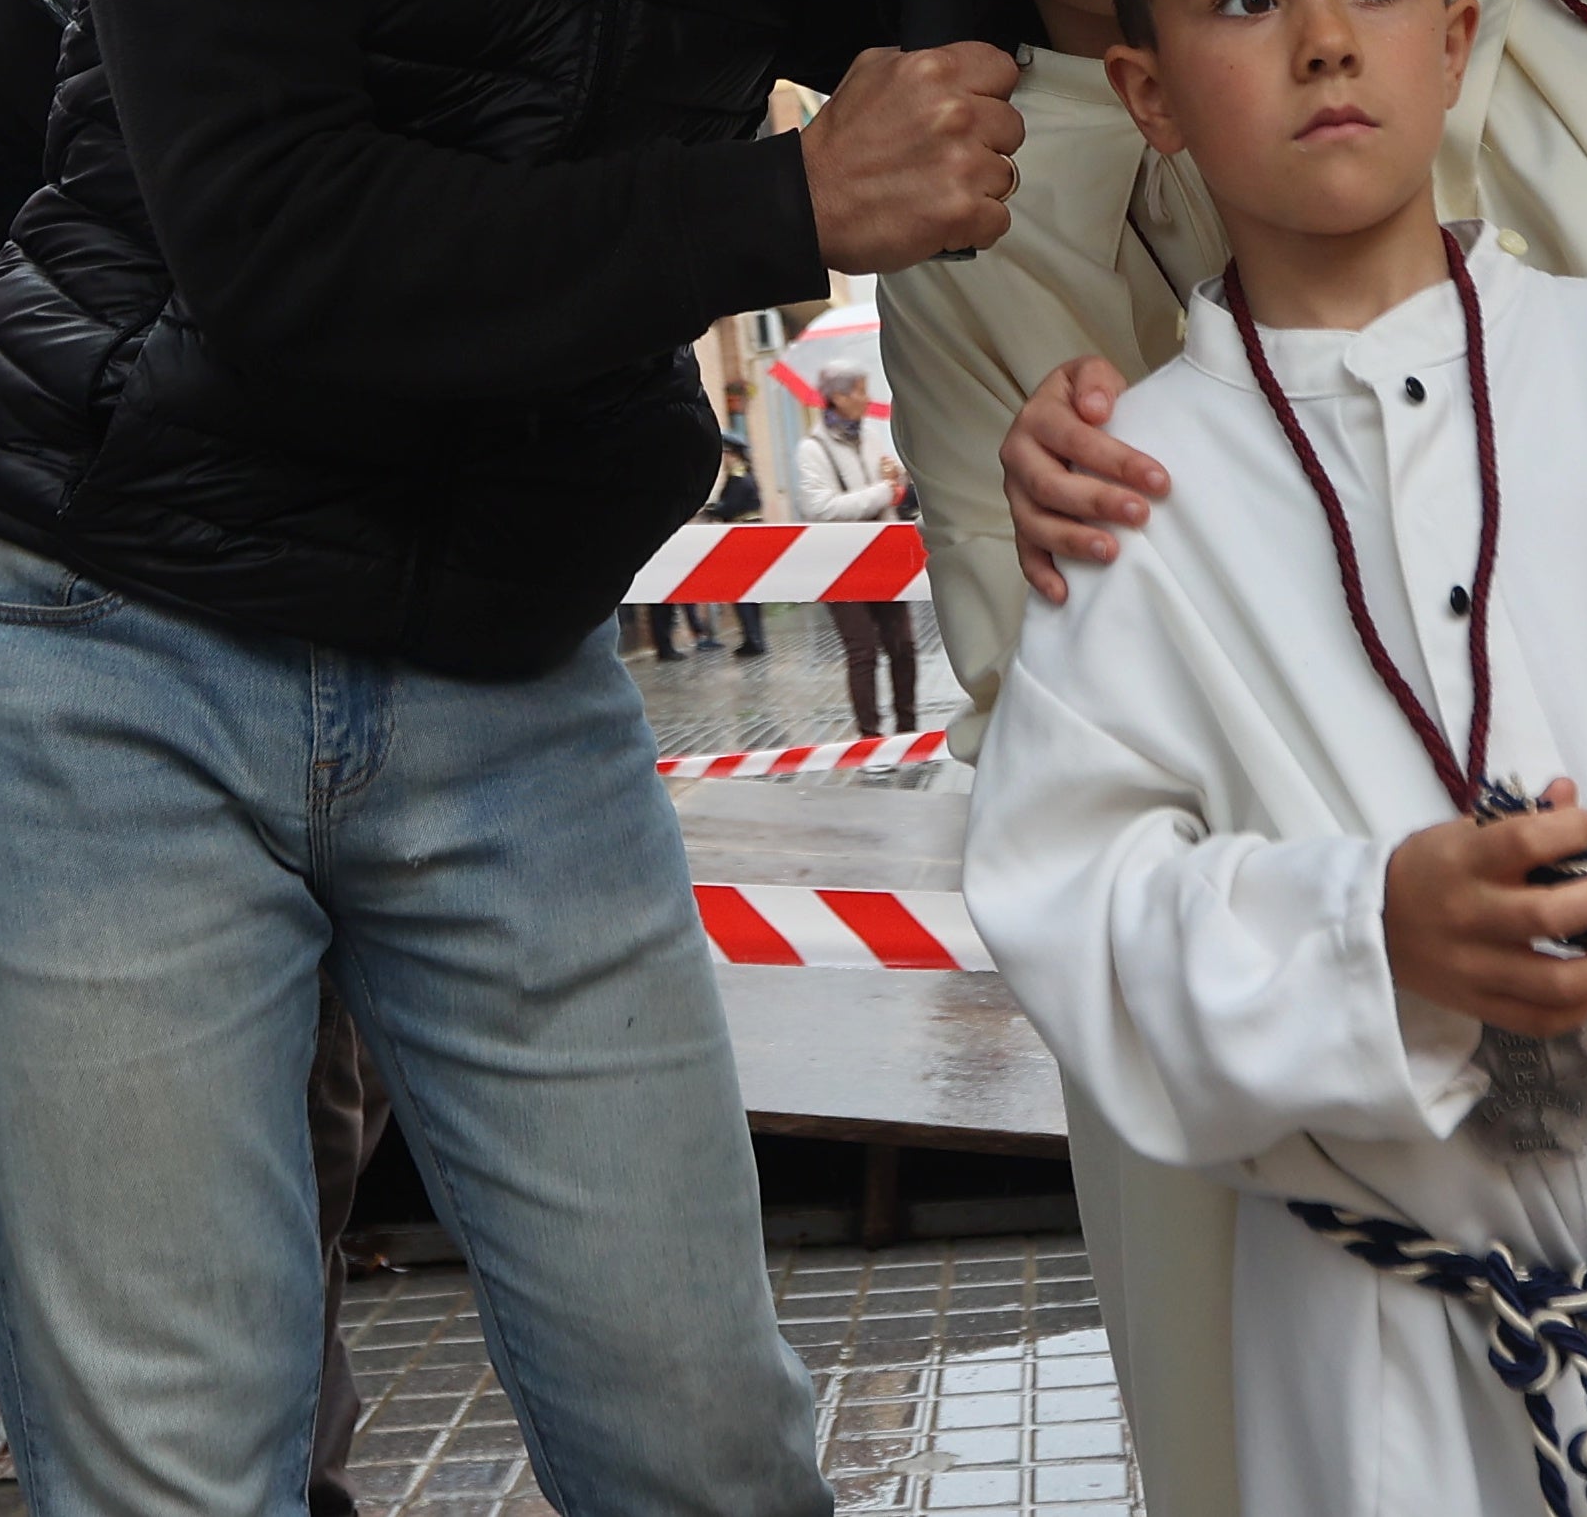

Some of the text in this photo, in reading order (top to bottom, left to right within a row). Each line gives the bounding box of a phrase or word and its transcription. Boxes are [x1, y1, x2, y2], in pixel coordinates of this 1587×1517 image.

[1508, 1050, 1541, 1065] SRA
[1514, 1071, 1535, 1085] DE
[1506, 1089, 1582, 1118] ESTRELLA
